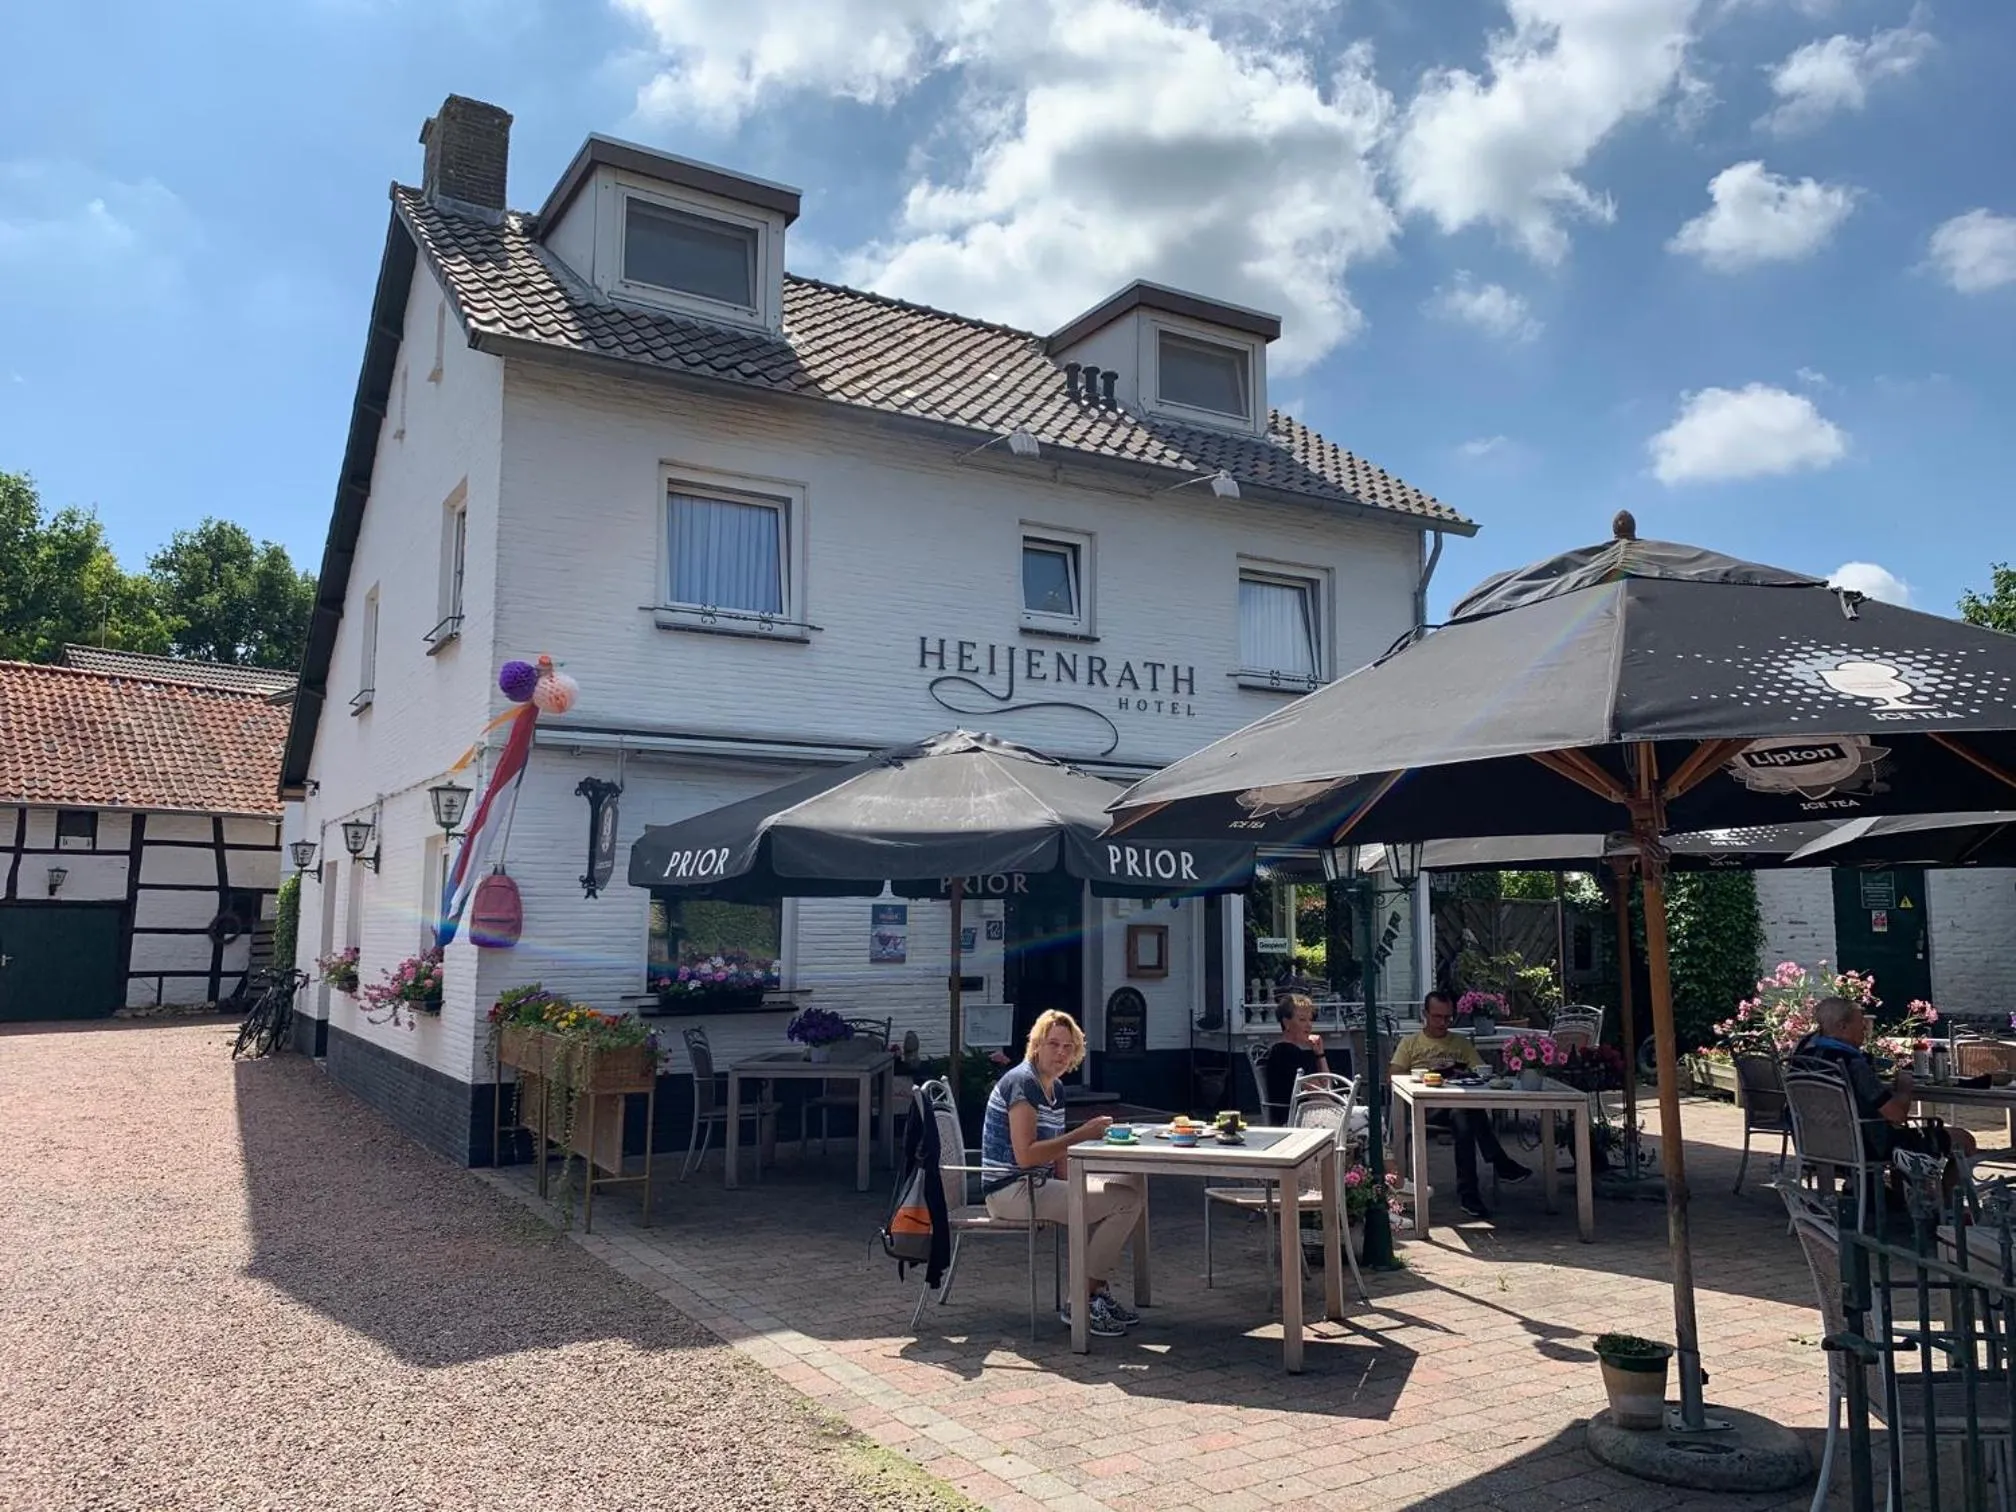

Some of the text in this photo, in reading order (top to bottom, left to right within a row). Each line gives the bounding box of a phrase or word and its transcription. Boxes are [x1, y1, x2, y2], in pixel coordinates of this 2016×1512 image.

[918, 636, 1196, 701] HEIJENRATH
[1117, 696, 1197, 717] HOTEL
[1750, 747, 1837, 766] Lipton
[1828, 800, 1860, 808] TEA
[661, 847, 730, 878] PRIOR
[1106, 843, 1201, 880] PRIOR
